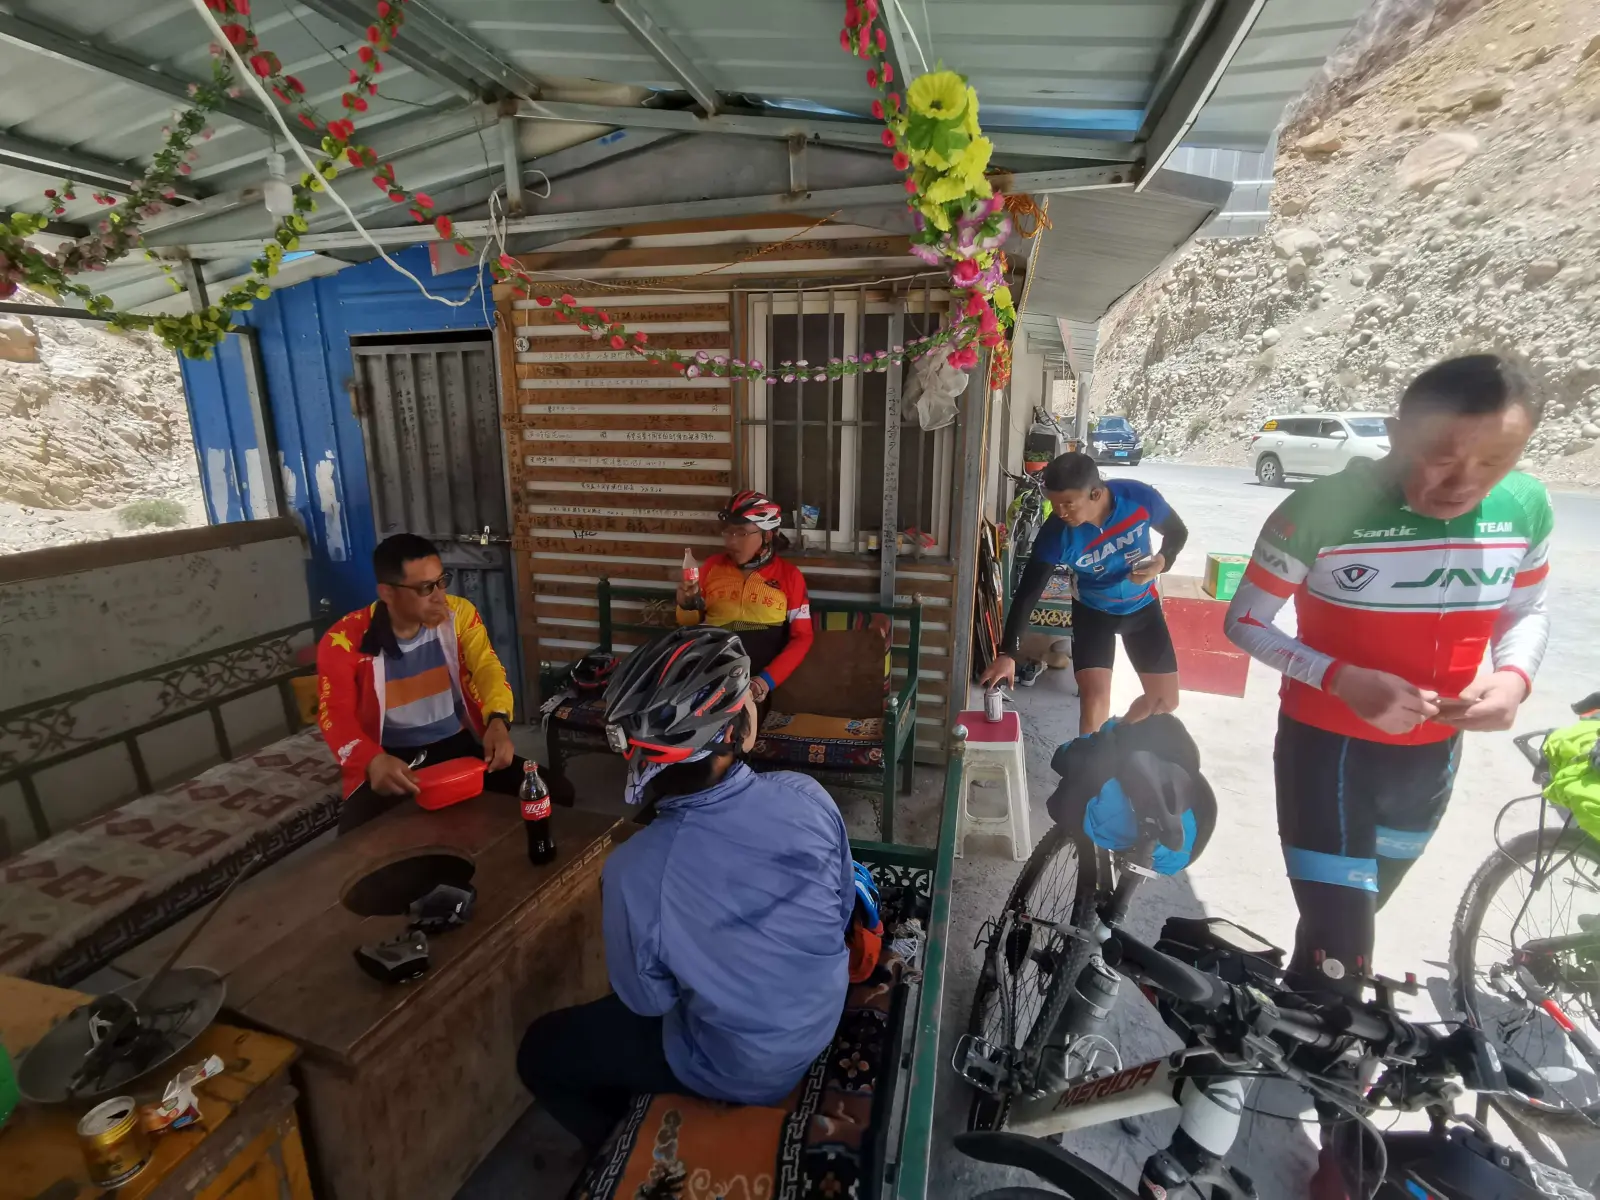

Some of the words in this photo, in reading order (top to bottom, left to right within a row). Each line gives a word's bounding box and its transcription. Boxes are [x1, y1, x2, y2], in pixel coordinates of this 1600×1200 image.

[1352, 525, 1417, 539] Santic
[1478, 522, 1512, 533] TEAM
[1075, 522, 1146, 567] GIANT
[1391, 566, 1516, 588] JAVA
[1052, 1060, 1162, 1111] MERIDA
